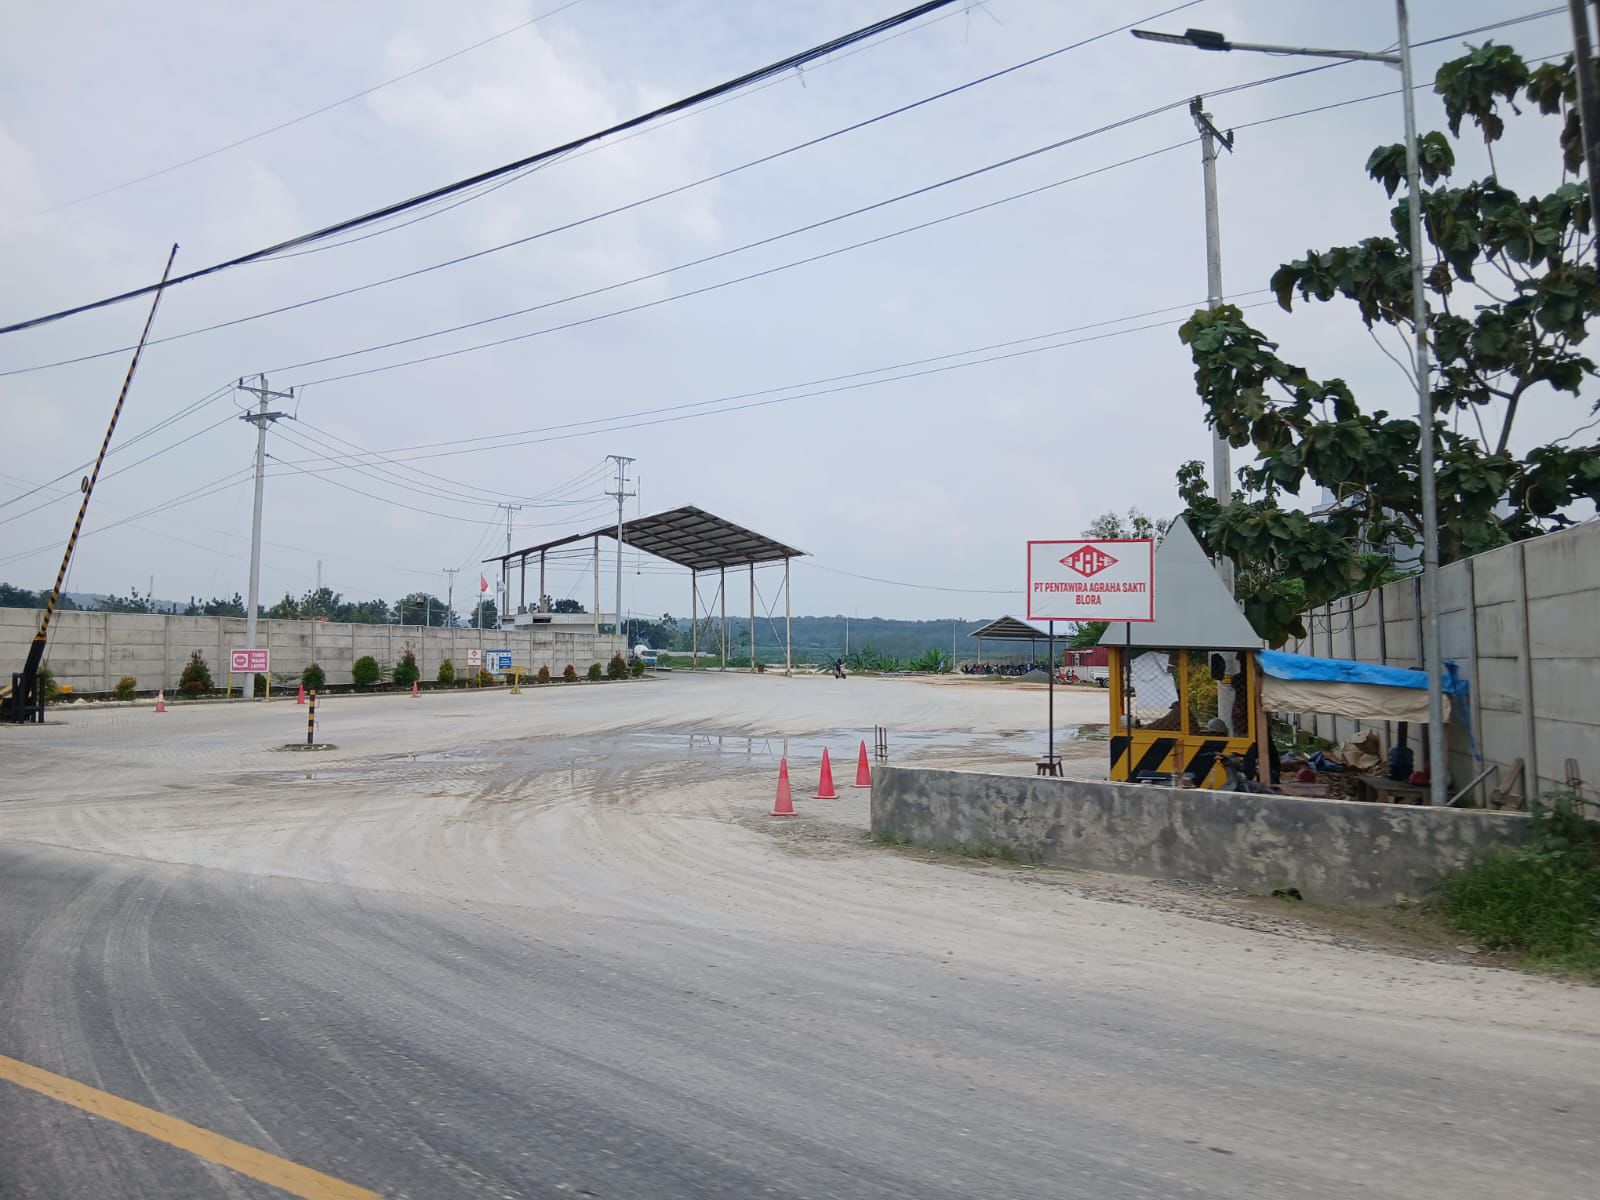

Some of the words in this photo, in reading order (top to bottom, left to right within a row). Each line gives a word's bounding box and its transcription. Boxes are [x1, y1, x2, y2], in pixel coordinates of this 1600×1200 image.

[1034, 582, 1044, 592] PT
[1045, 582, 1088, 592] PENTAWIRA
[1089, 582, 1121, 592] AGRAHA
[1122, 582, 1146, 592] SAKTI
[1076, 595, 1101, 605] BLORA
